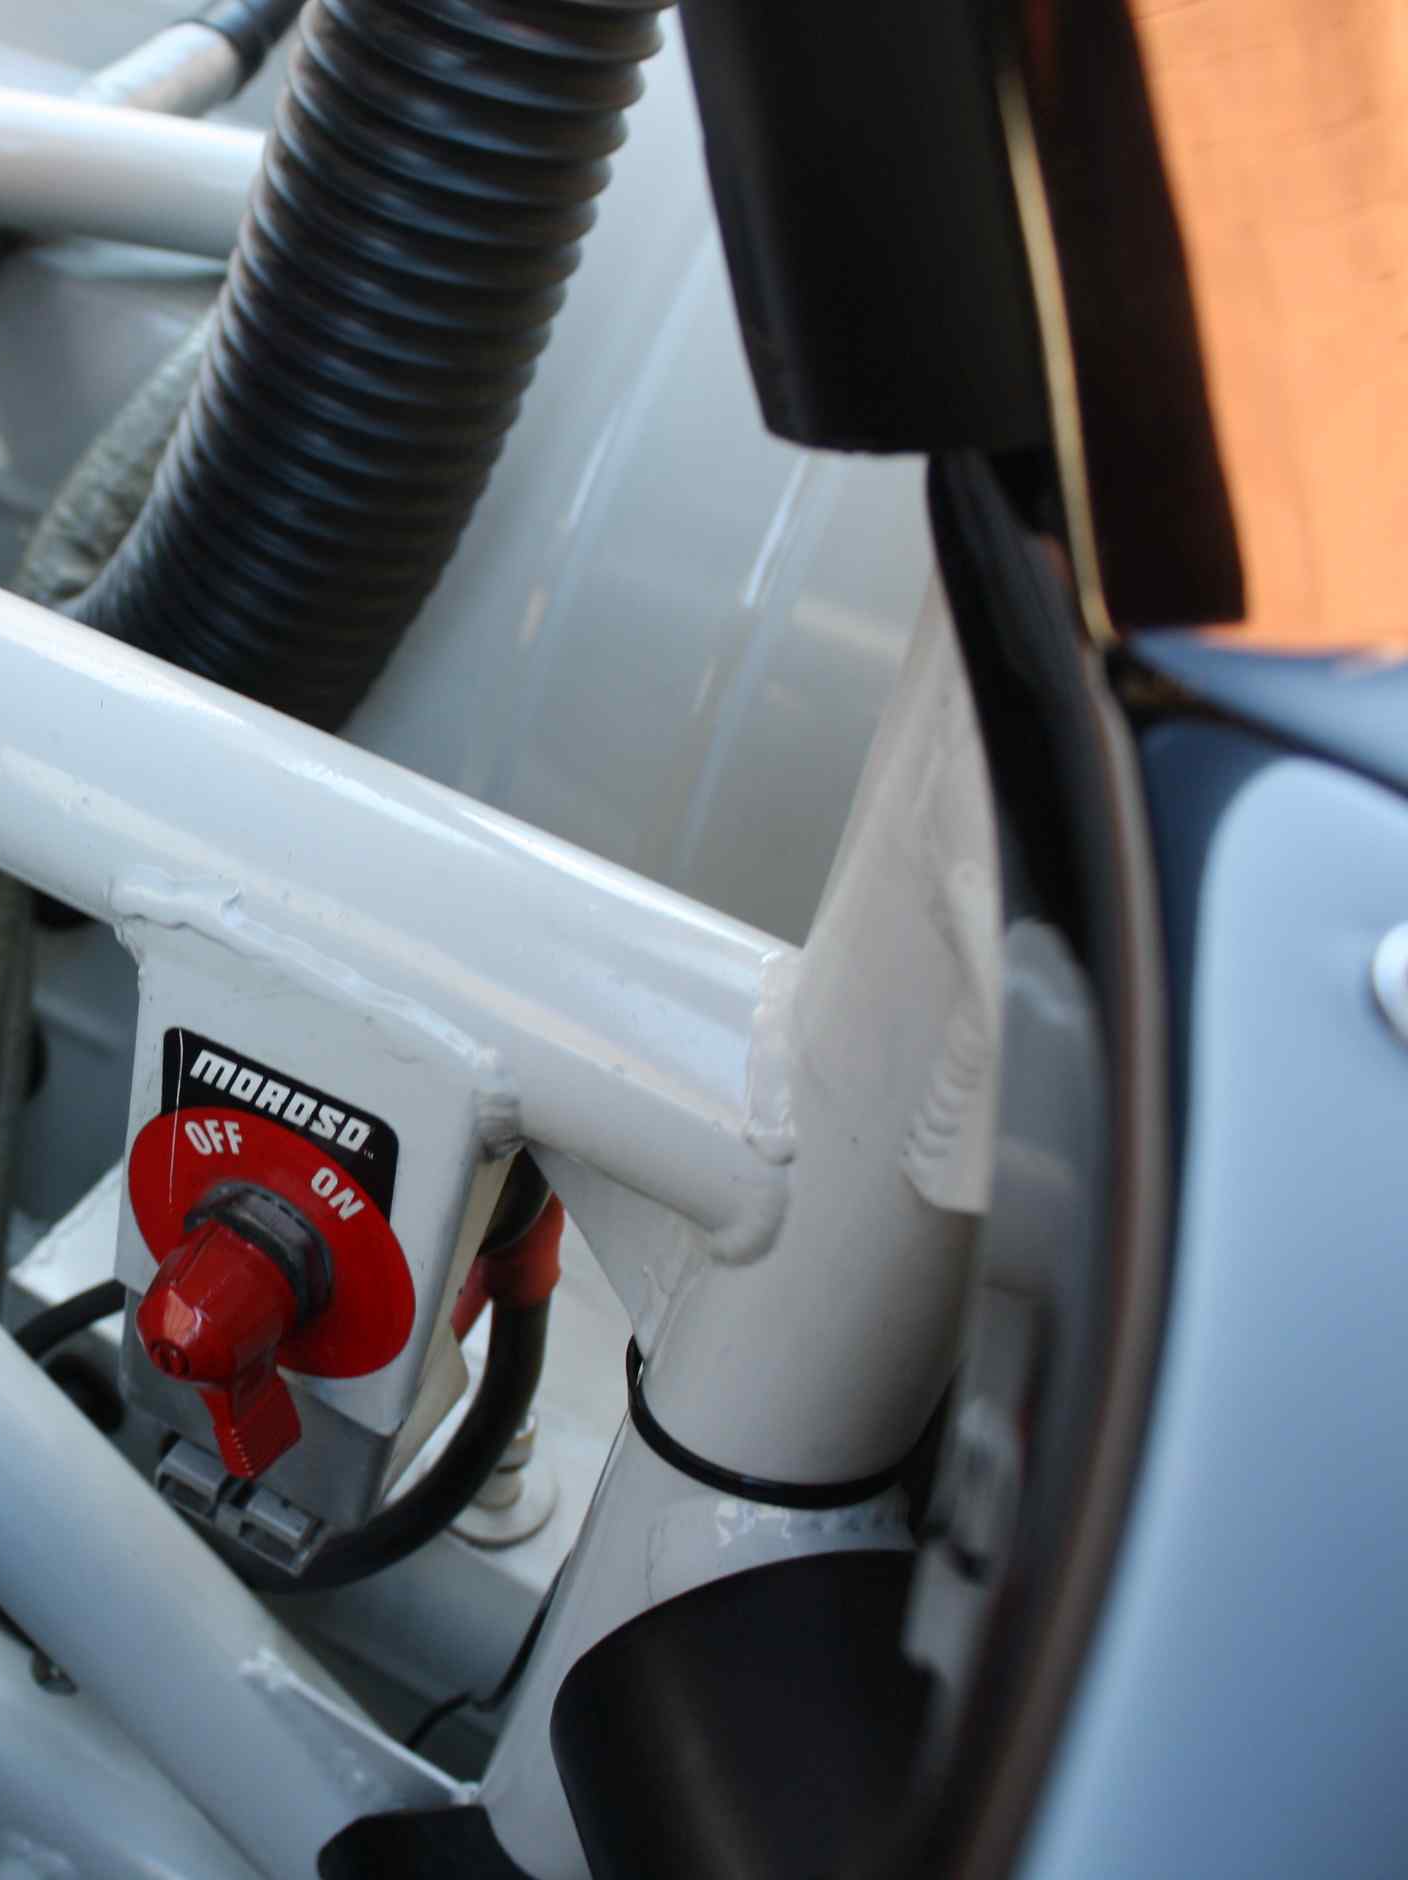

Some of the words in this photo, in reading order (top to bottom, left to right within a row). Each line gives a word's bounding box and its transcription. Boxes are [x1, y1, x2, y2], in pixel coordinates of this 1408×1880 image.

[190, 1049, 371, 1152] MOROSO
[184, 1119, 243, 1156] OFF
[310, 1166, 365, 1222] ON
